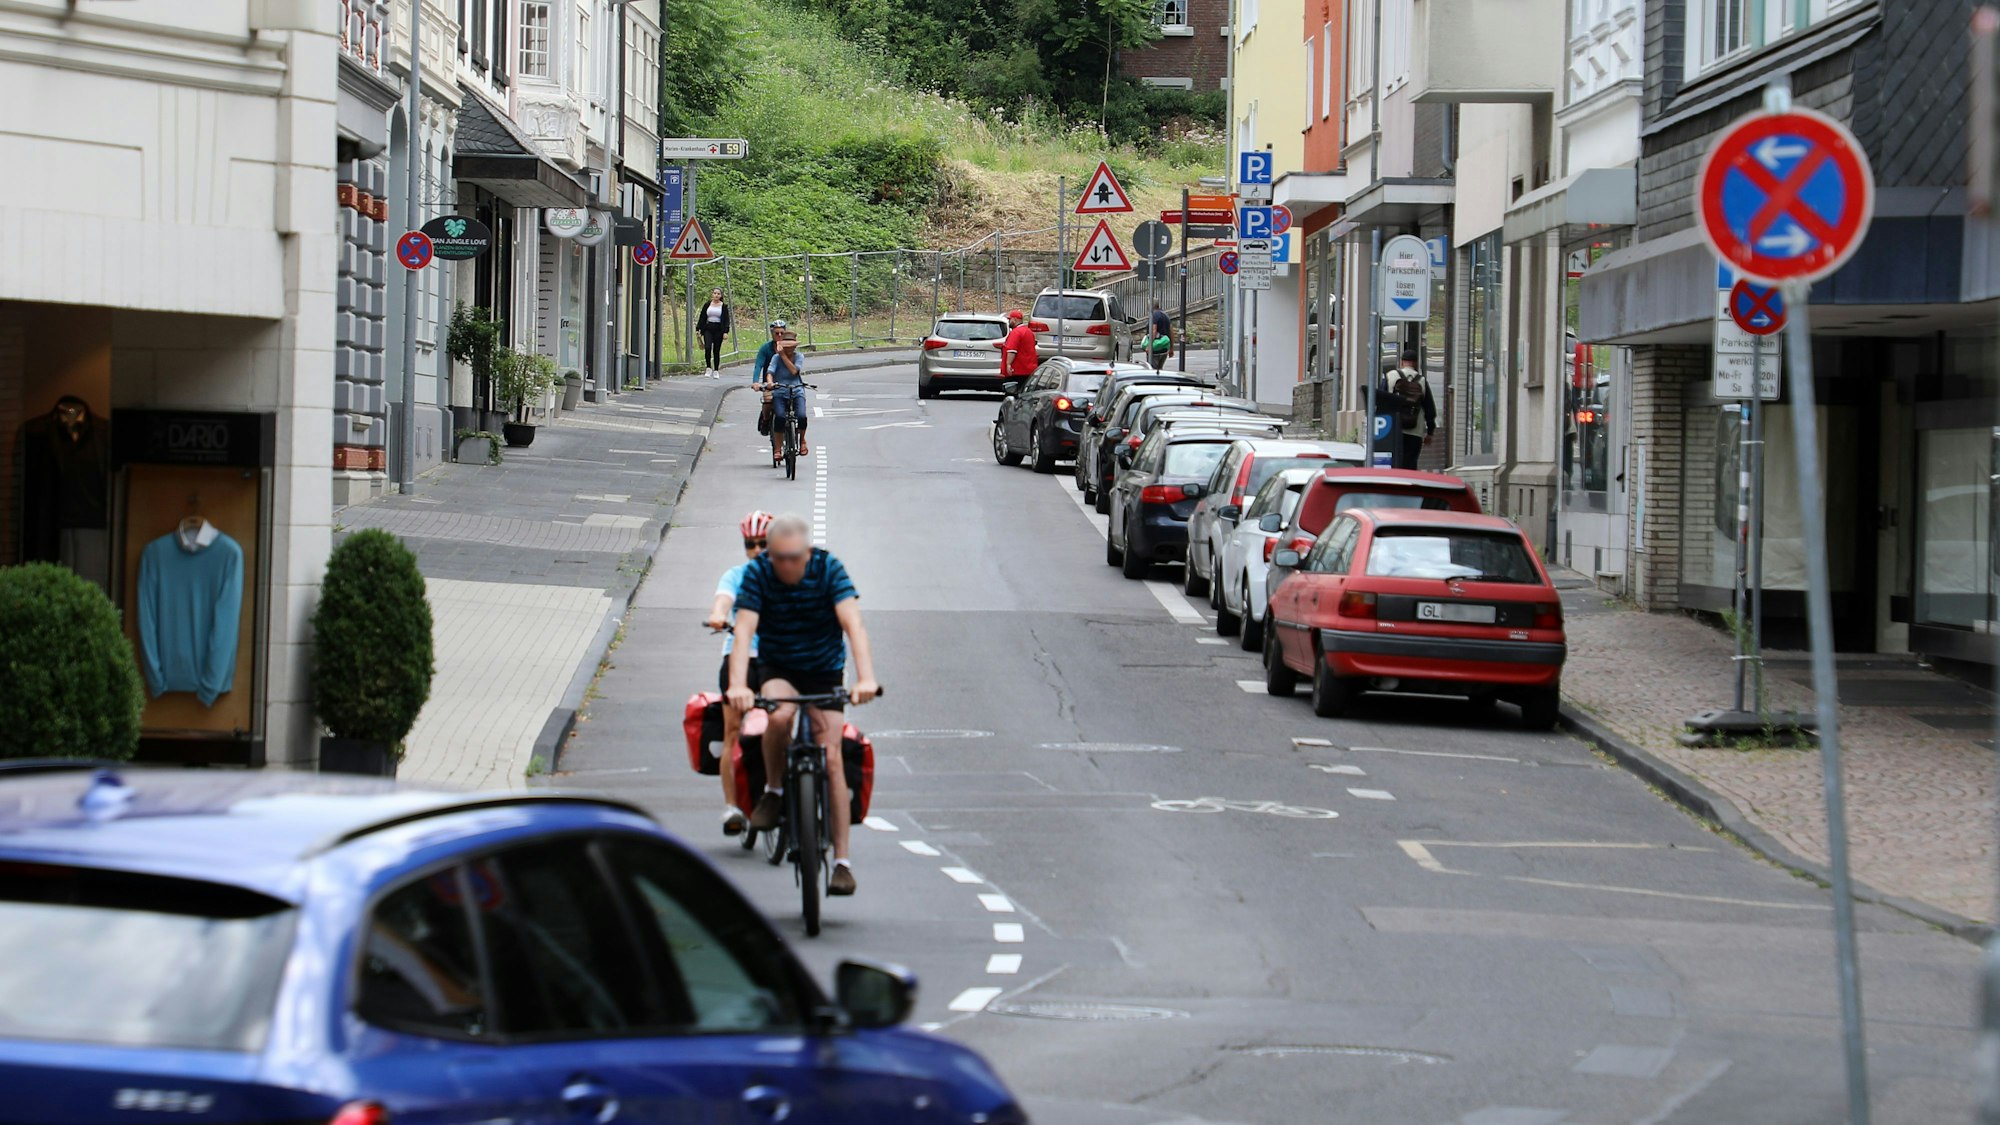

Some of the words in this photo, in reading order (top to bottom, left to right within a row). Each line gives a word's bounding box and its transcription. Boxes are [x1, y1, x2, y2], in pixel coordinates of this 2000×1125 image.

[726, 143, 739, 154] 59
[1247, 155, 1266, 181] P
[1247, 210, 1265, 236] P
[1399, 251, 1414, 259] Hier
[1386, 265, 1427, 275] Parkschein
[1732, 383, 1742, 392] Sa
[1374, 416, 1387, 436] P
[168, 424, 229, 449] DARIO
[1422, 605, 1440, 618] GL
